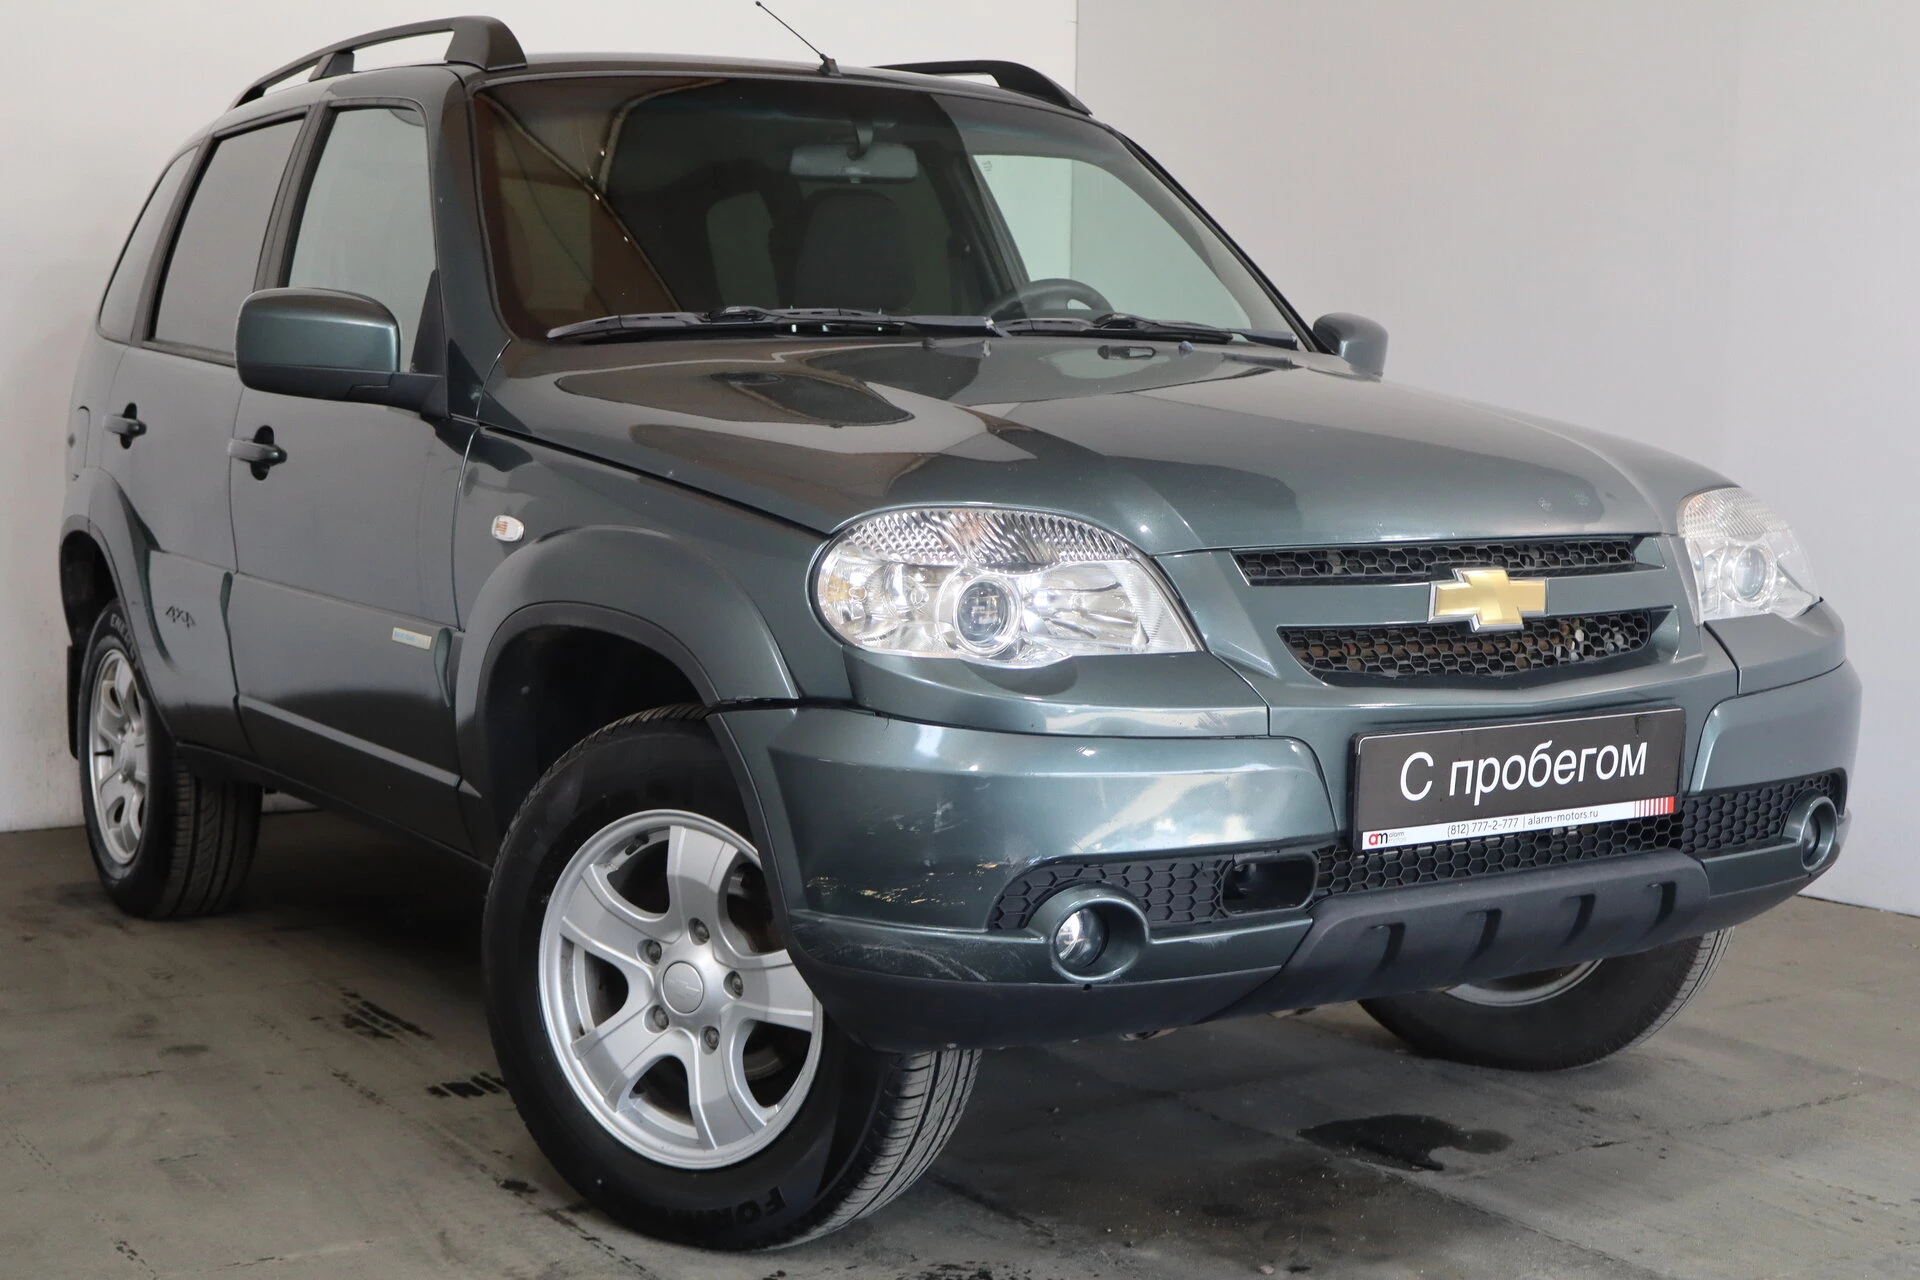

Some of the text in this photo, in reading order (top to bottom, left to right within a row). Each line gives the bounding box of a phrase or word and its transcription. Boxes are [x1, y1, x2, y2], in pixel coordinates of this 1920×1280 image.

[1400, 740, 1648, 806] С пробегом
[1447, 810, 1599, 837] (812) 777-2-777 alarm-motors.ru
